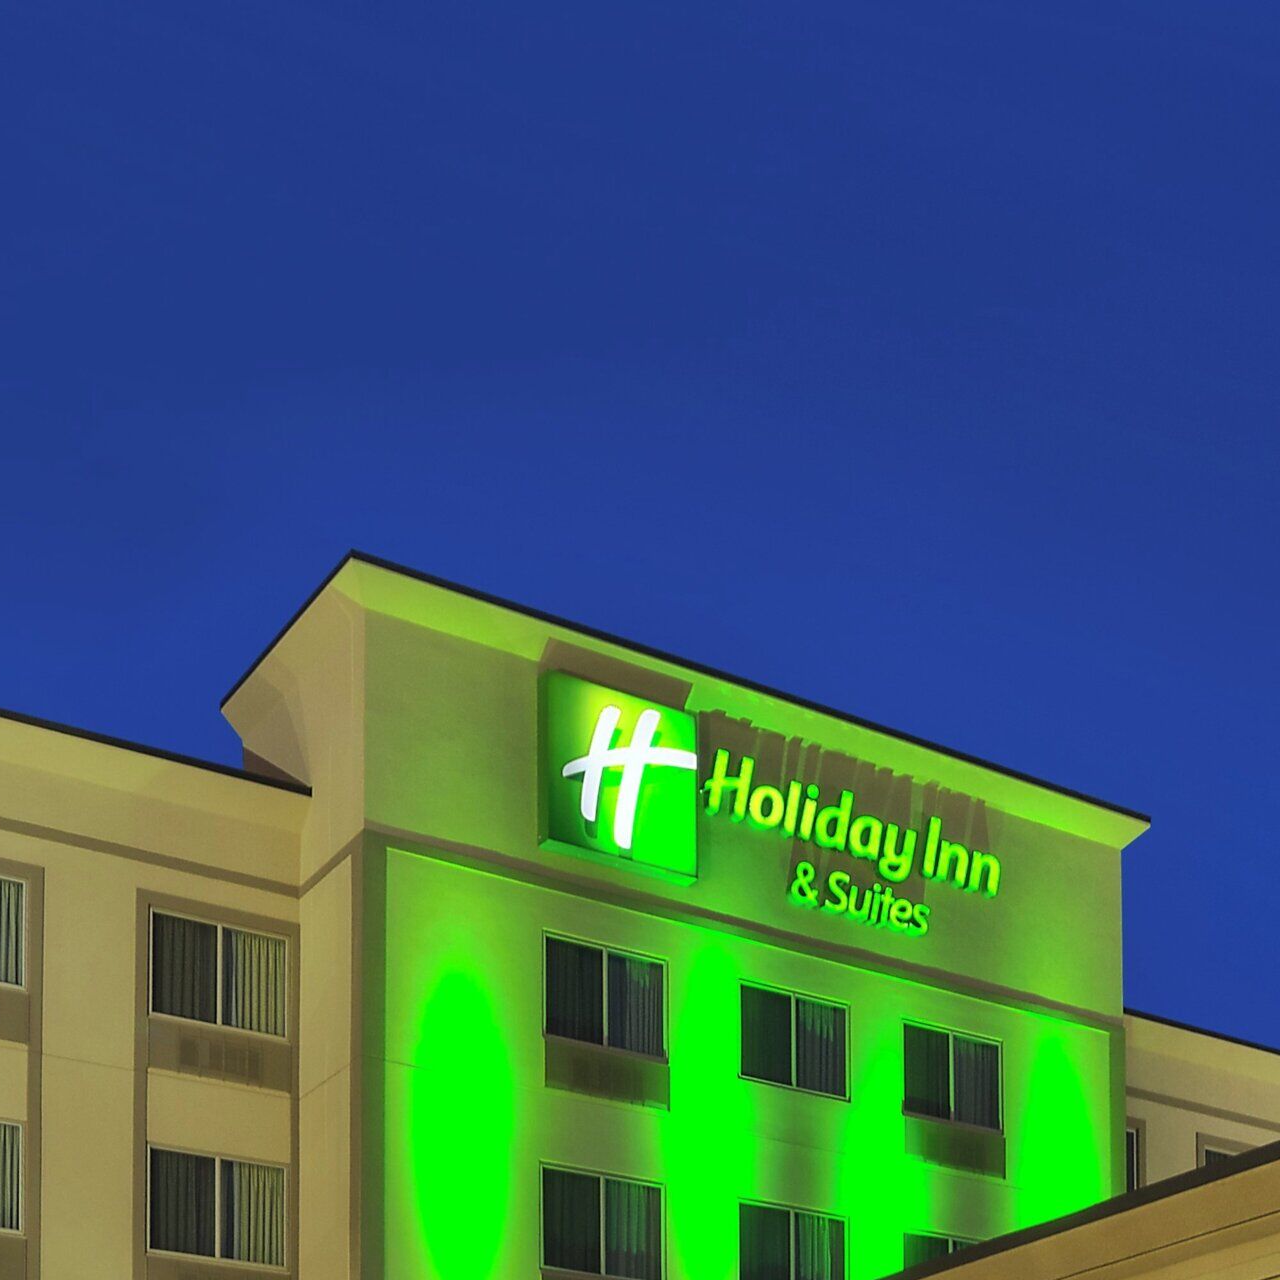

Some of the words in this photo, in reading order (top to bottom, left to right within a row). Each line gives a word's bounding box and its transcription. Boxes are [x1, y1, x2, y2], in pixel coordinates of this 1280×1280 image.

[704, 749, 917, 882] Holiday
[922, 815, 1000, 898] Inn
[789, 861, 819, 908] &
[821, 871, 931, 937] Suites
